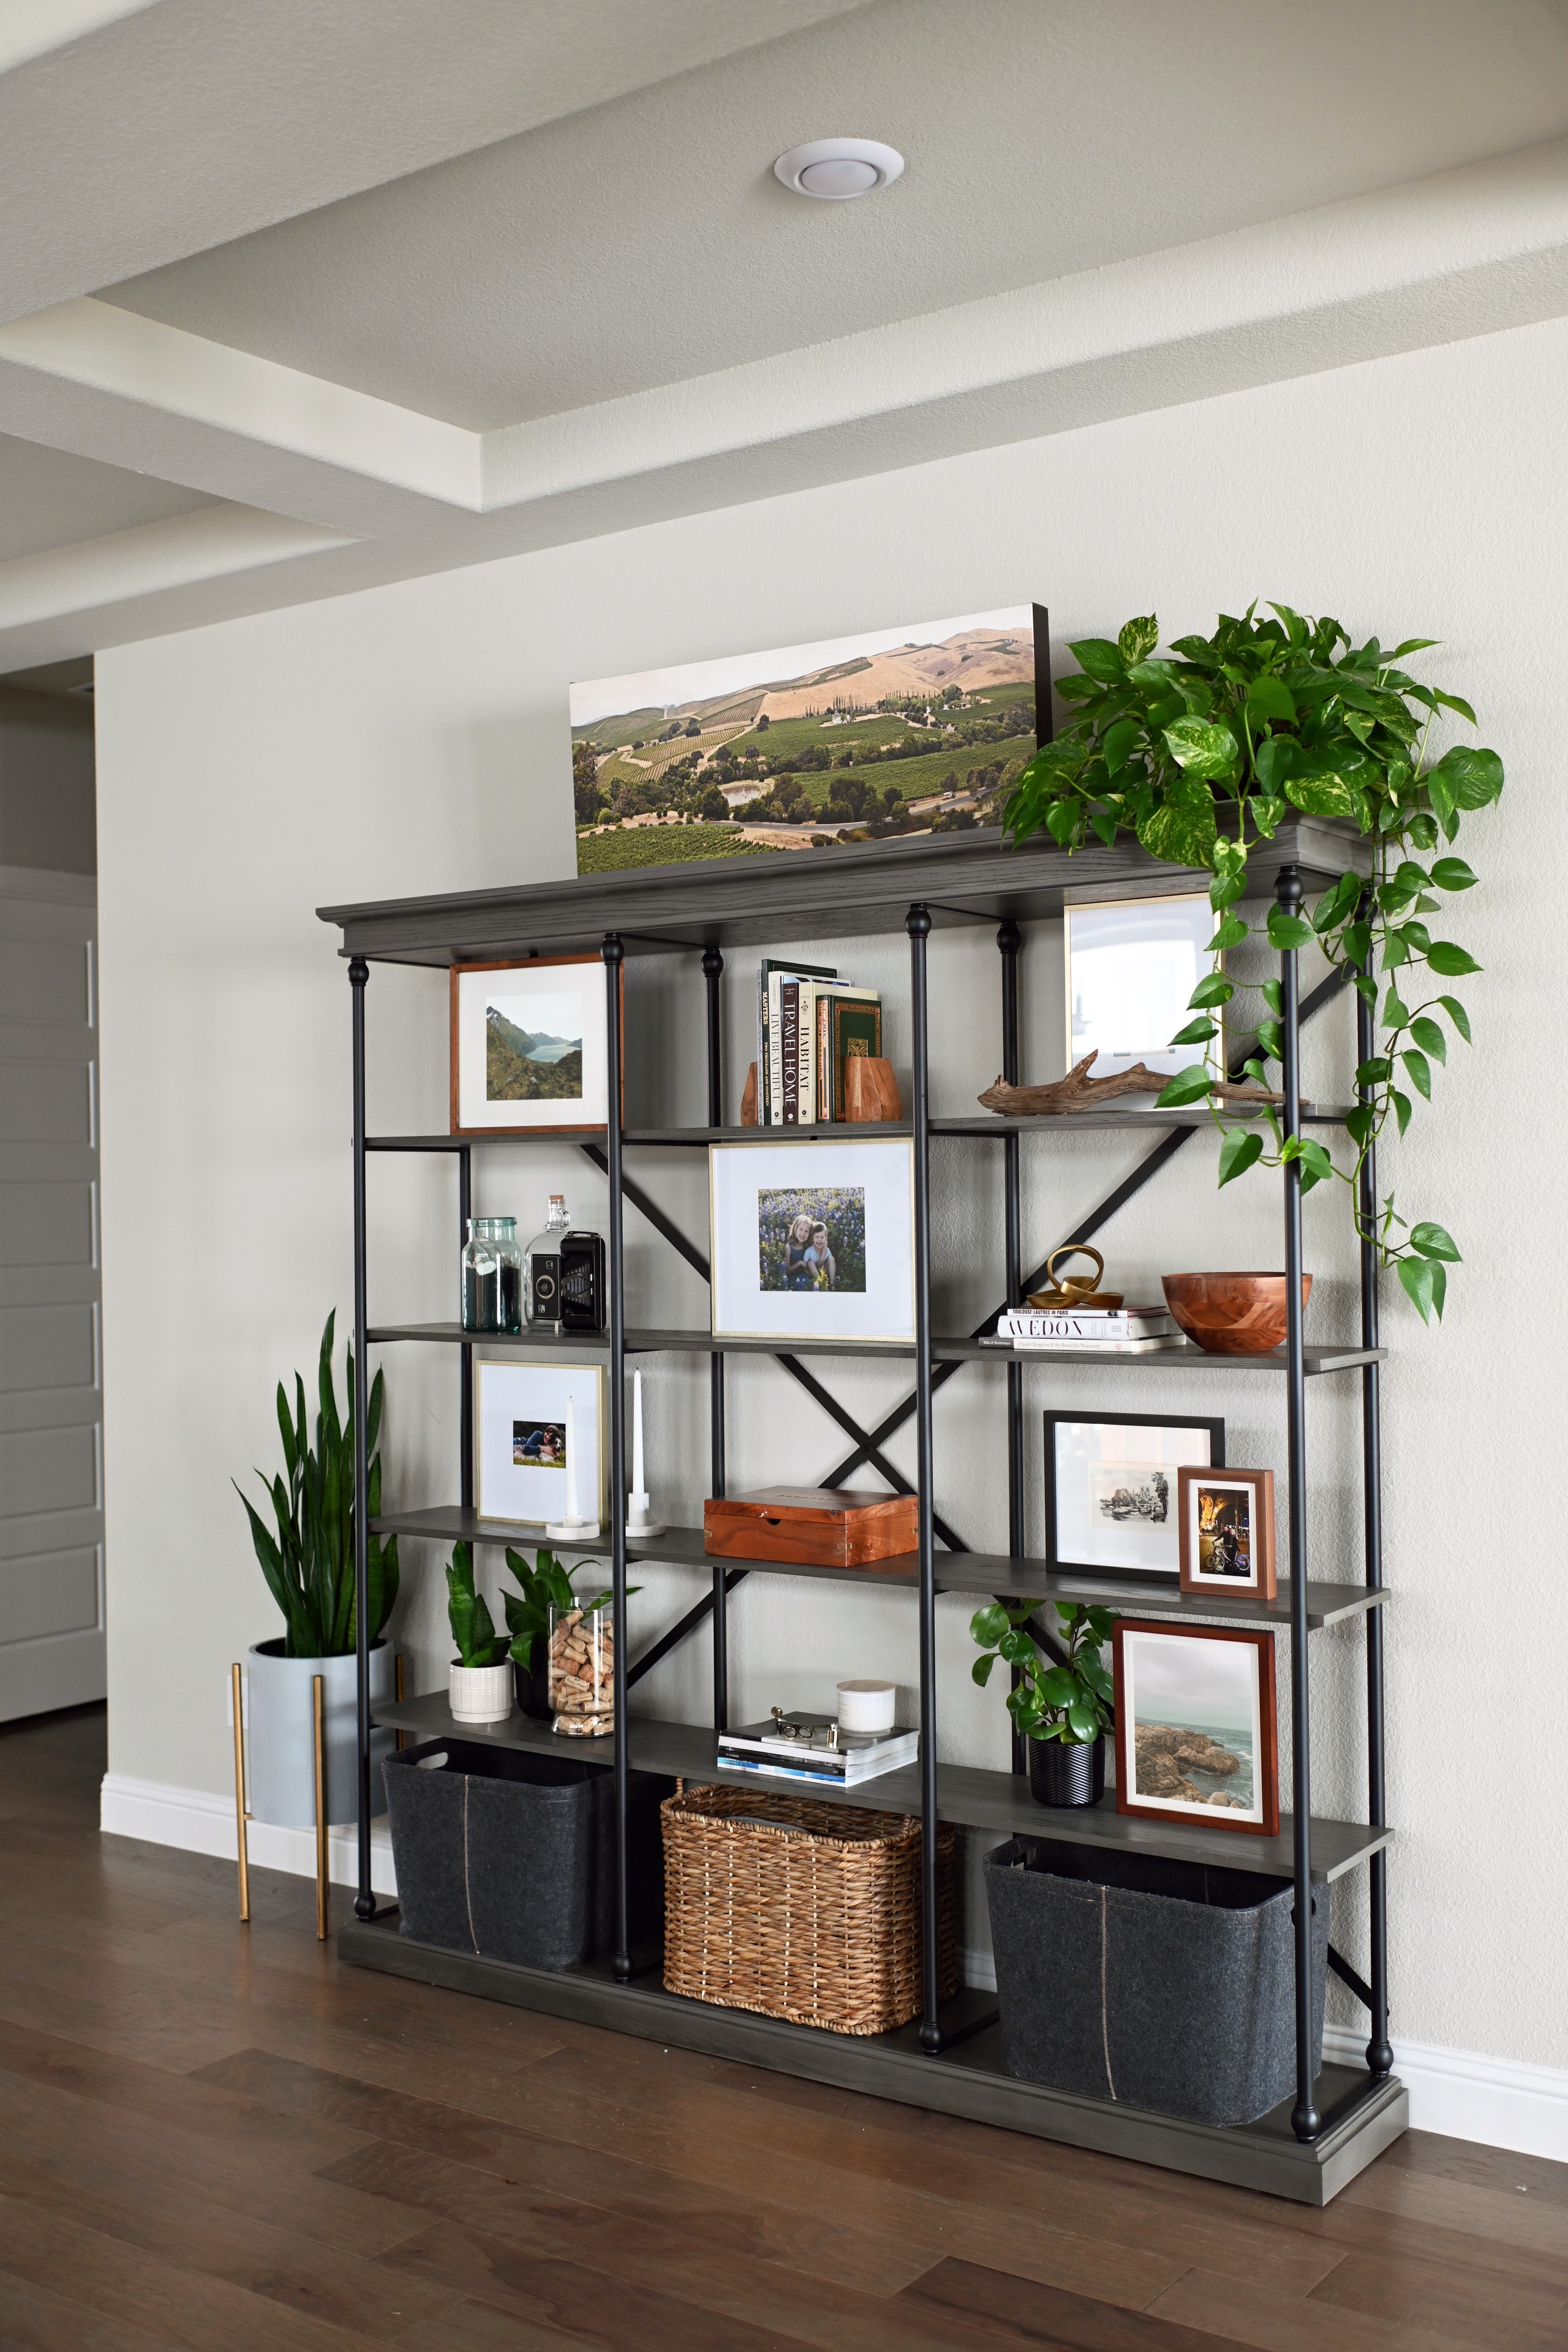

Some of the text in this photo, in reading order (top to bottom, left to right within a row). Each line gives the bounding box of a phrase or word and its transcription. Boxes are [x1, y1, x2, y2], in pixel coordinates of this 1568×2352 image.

[771, 1041, 780, 1102] BEAUTIFUL
[785, 1001, 796, 1106] TRAVEL HOME
[1008, 1320, 1082, 1336] AVEDON
